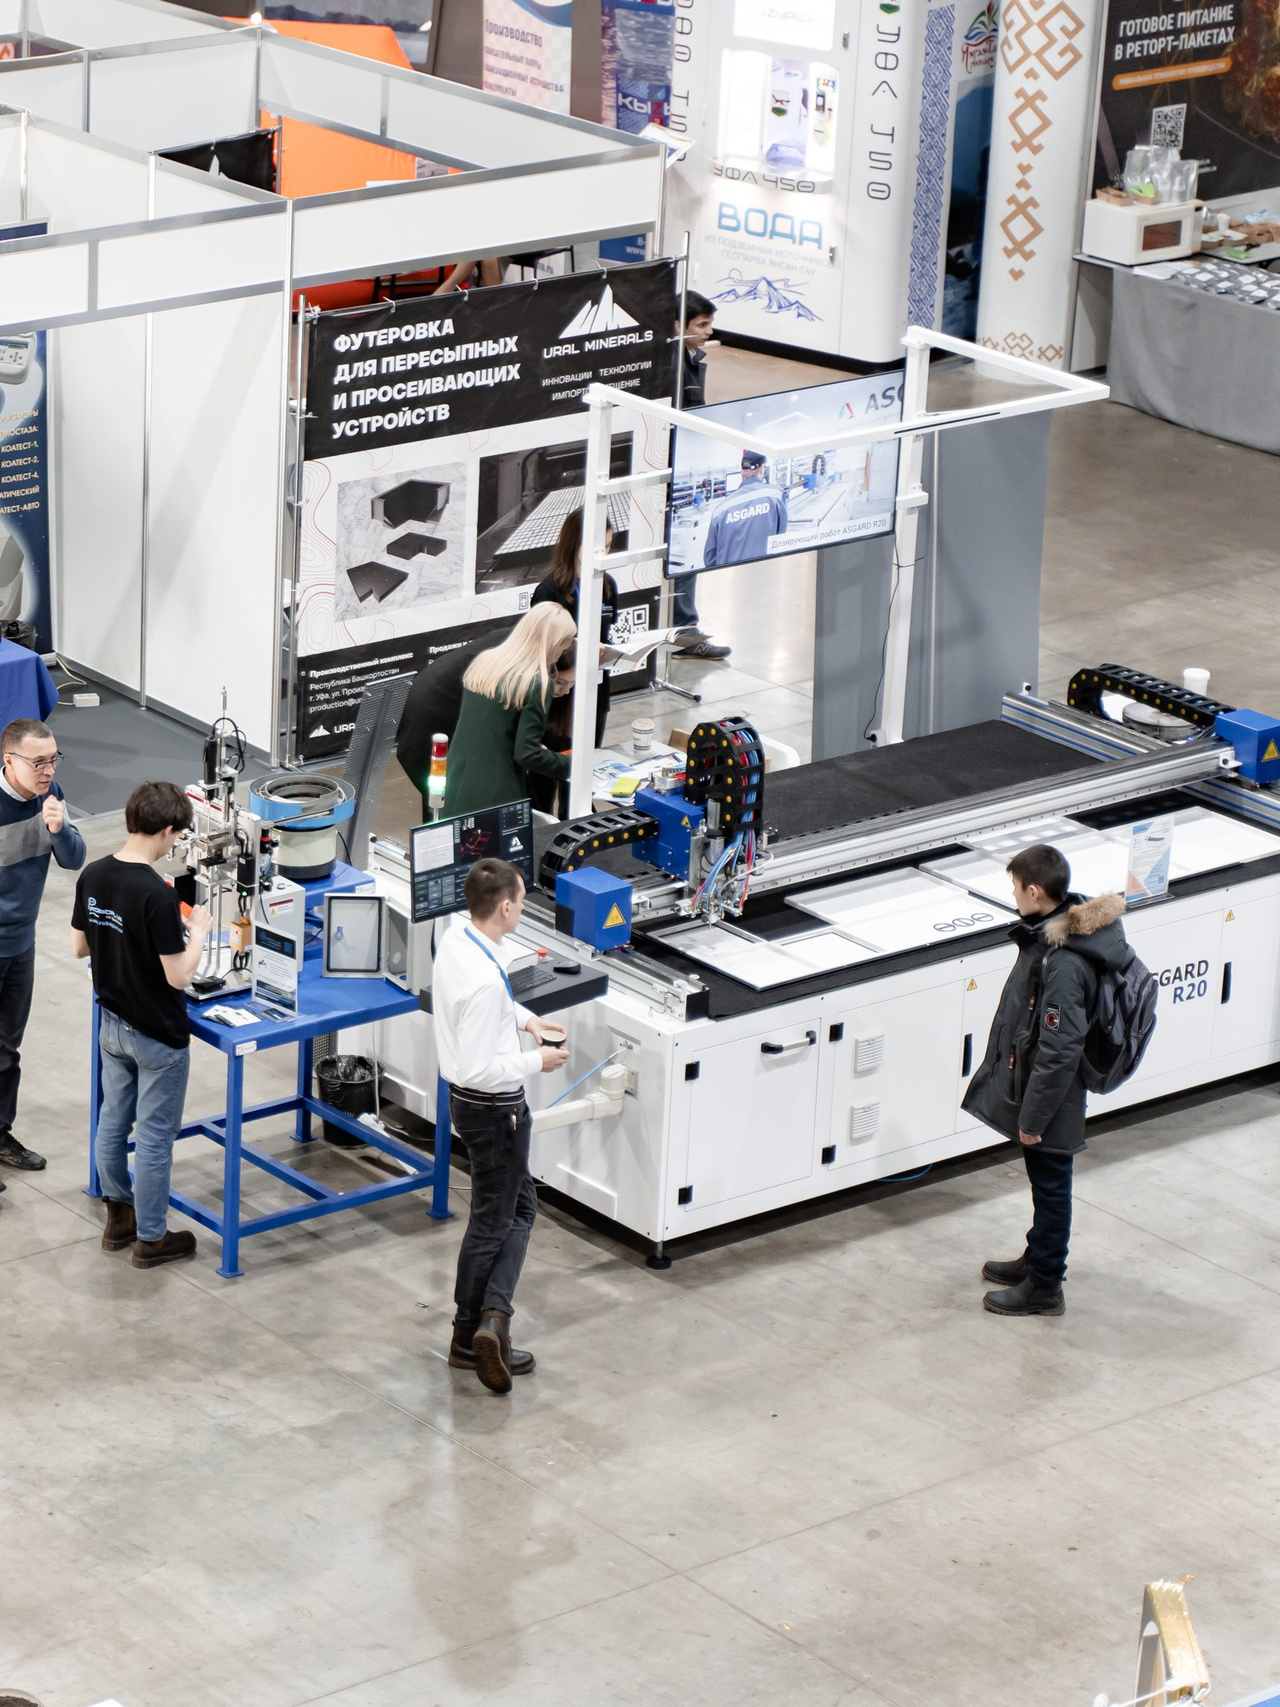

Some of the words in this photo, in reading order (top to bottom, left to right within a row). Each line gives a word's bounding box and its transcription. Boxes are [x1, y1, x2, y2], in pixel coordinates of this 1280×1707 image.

[484, 19, 544, 48] ПРОИЗВОДСТВО
[1119, 13, 1175, 38] ГОТОВОЕ
[1177, 4, 1235, 29] ПИТАНИЕ
[1114, 44, 1123, 61] В
[1126, 26, 1236, 59] РЕТОРТ-ПАКЕТАХ
[717, 201, 823, 250] ВОДА
[704, 234, 716, 244] ИЗ
[718, 236, 773, 256] ПОДЗЕМНЫХ
[721, 248, 767, 266] ГЕОПАРКА
[333, 317, 455, 354] ФУТЕРОВКА
[543, 341, 580, 359] URAL
[584, 330, 655, 353] MINERALS
[333, 356, 378, 386] ДЛЯ
[381, 335, 519, 374] ПЕРЕСЫПНЫХ
[542, 371, 593, 387] ИННОВАЦИИ
[599, 360, 653, 377] ТЕХНОЛОГИИ
[333, 392, 348, 411] И
[350, 363, 521, 408] ПРОСЕИВАЮЩИХ
[332, 402, 451, 441] УСТРОЙСТВ
[725, 502, 770, 525] ASGARD
[771, 532, 819, 550] Дозирующий
[819, 528, 841, 542] робот
[842, 521, 872, 535] ASGARD
[872, 518, 887, 529] R20
[429, 641, 462, 654] Продажи
[309, 658, 379, 679] Производственный
[379, 652, 414, 665] комплекс
[309, 677, 351, 692] Республика
[351, 668, 400, 684] Башкортостан
[1172, 979, 1208, 1005] R20
